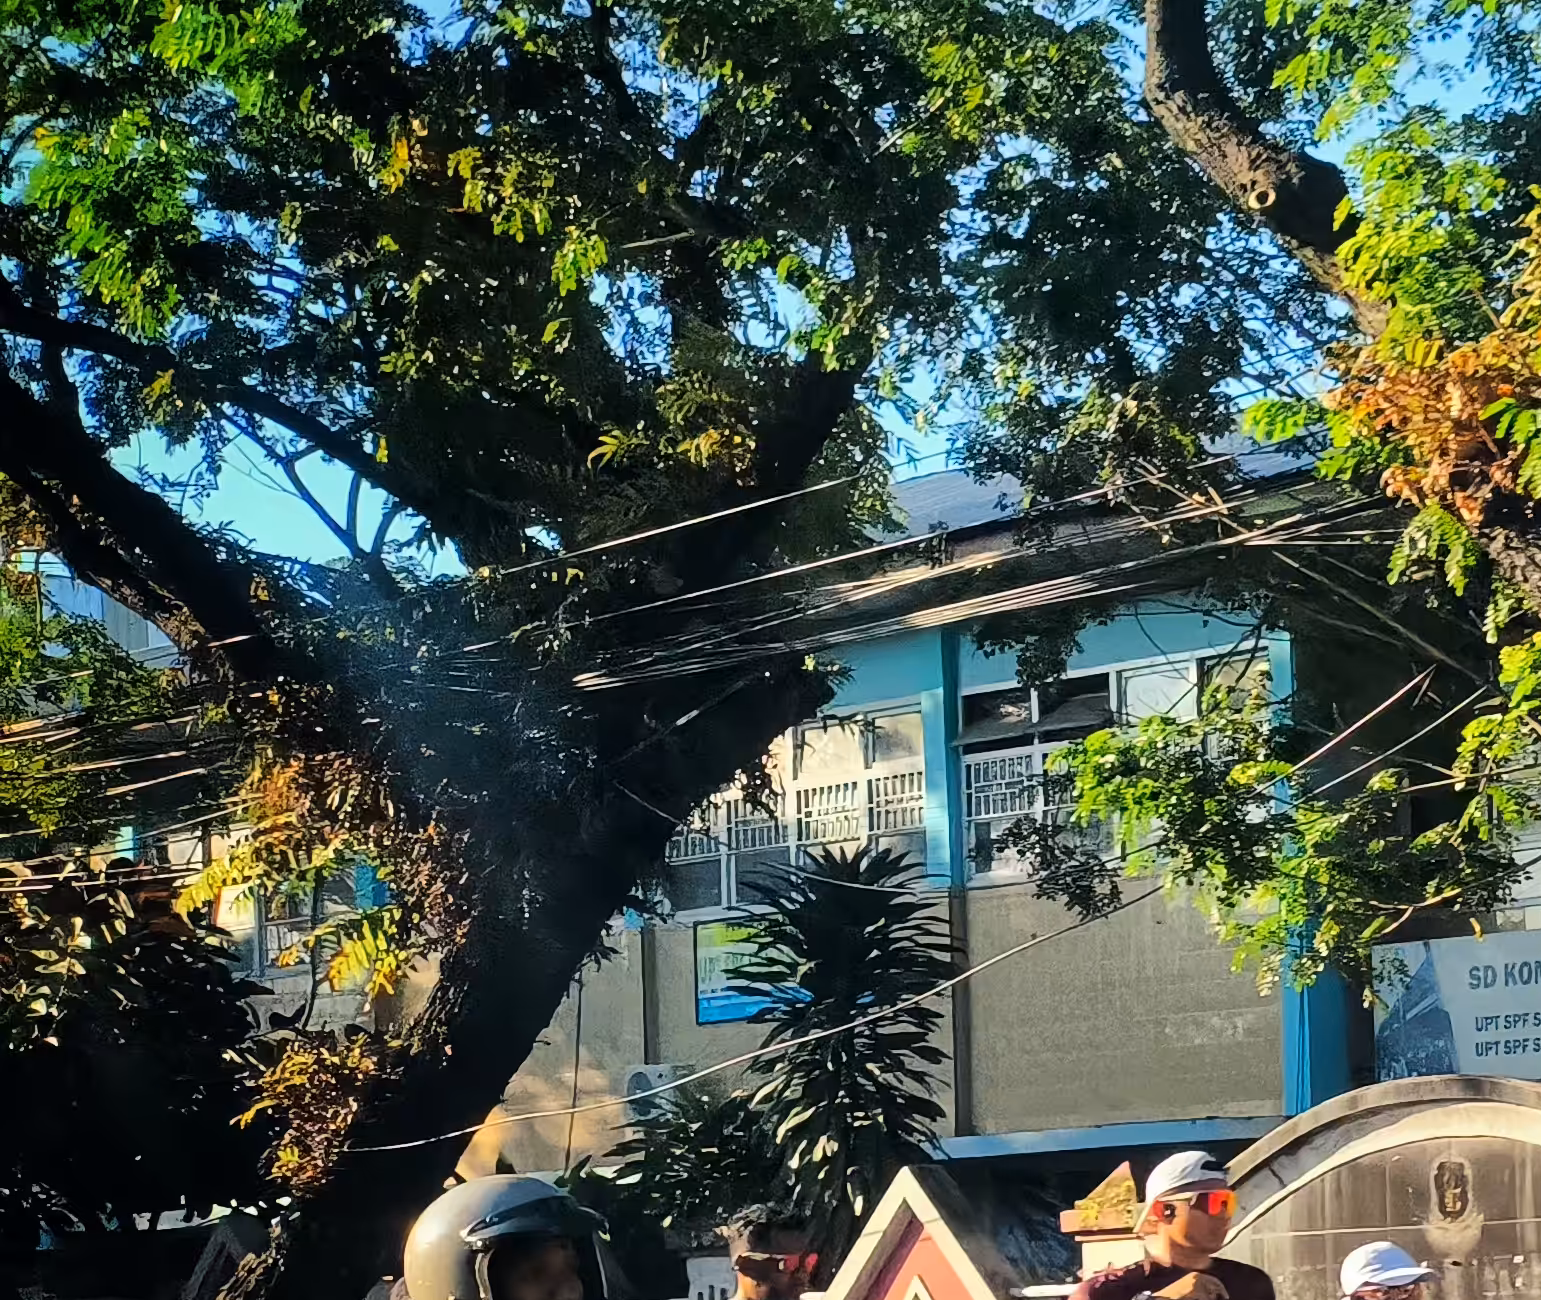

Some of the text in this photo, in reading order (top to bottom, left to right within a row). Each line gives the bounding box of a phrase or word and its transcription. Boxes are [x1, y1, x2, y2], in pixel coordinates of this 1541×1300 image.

[1468, 964, 1498, 990] SD
[1475, 1015, 1501, 1032] UPT
[1503, 1012, 1531, 1030] SPF
[1503, 1038, 1530, 1055] SPF
